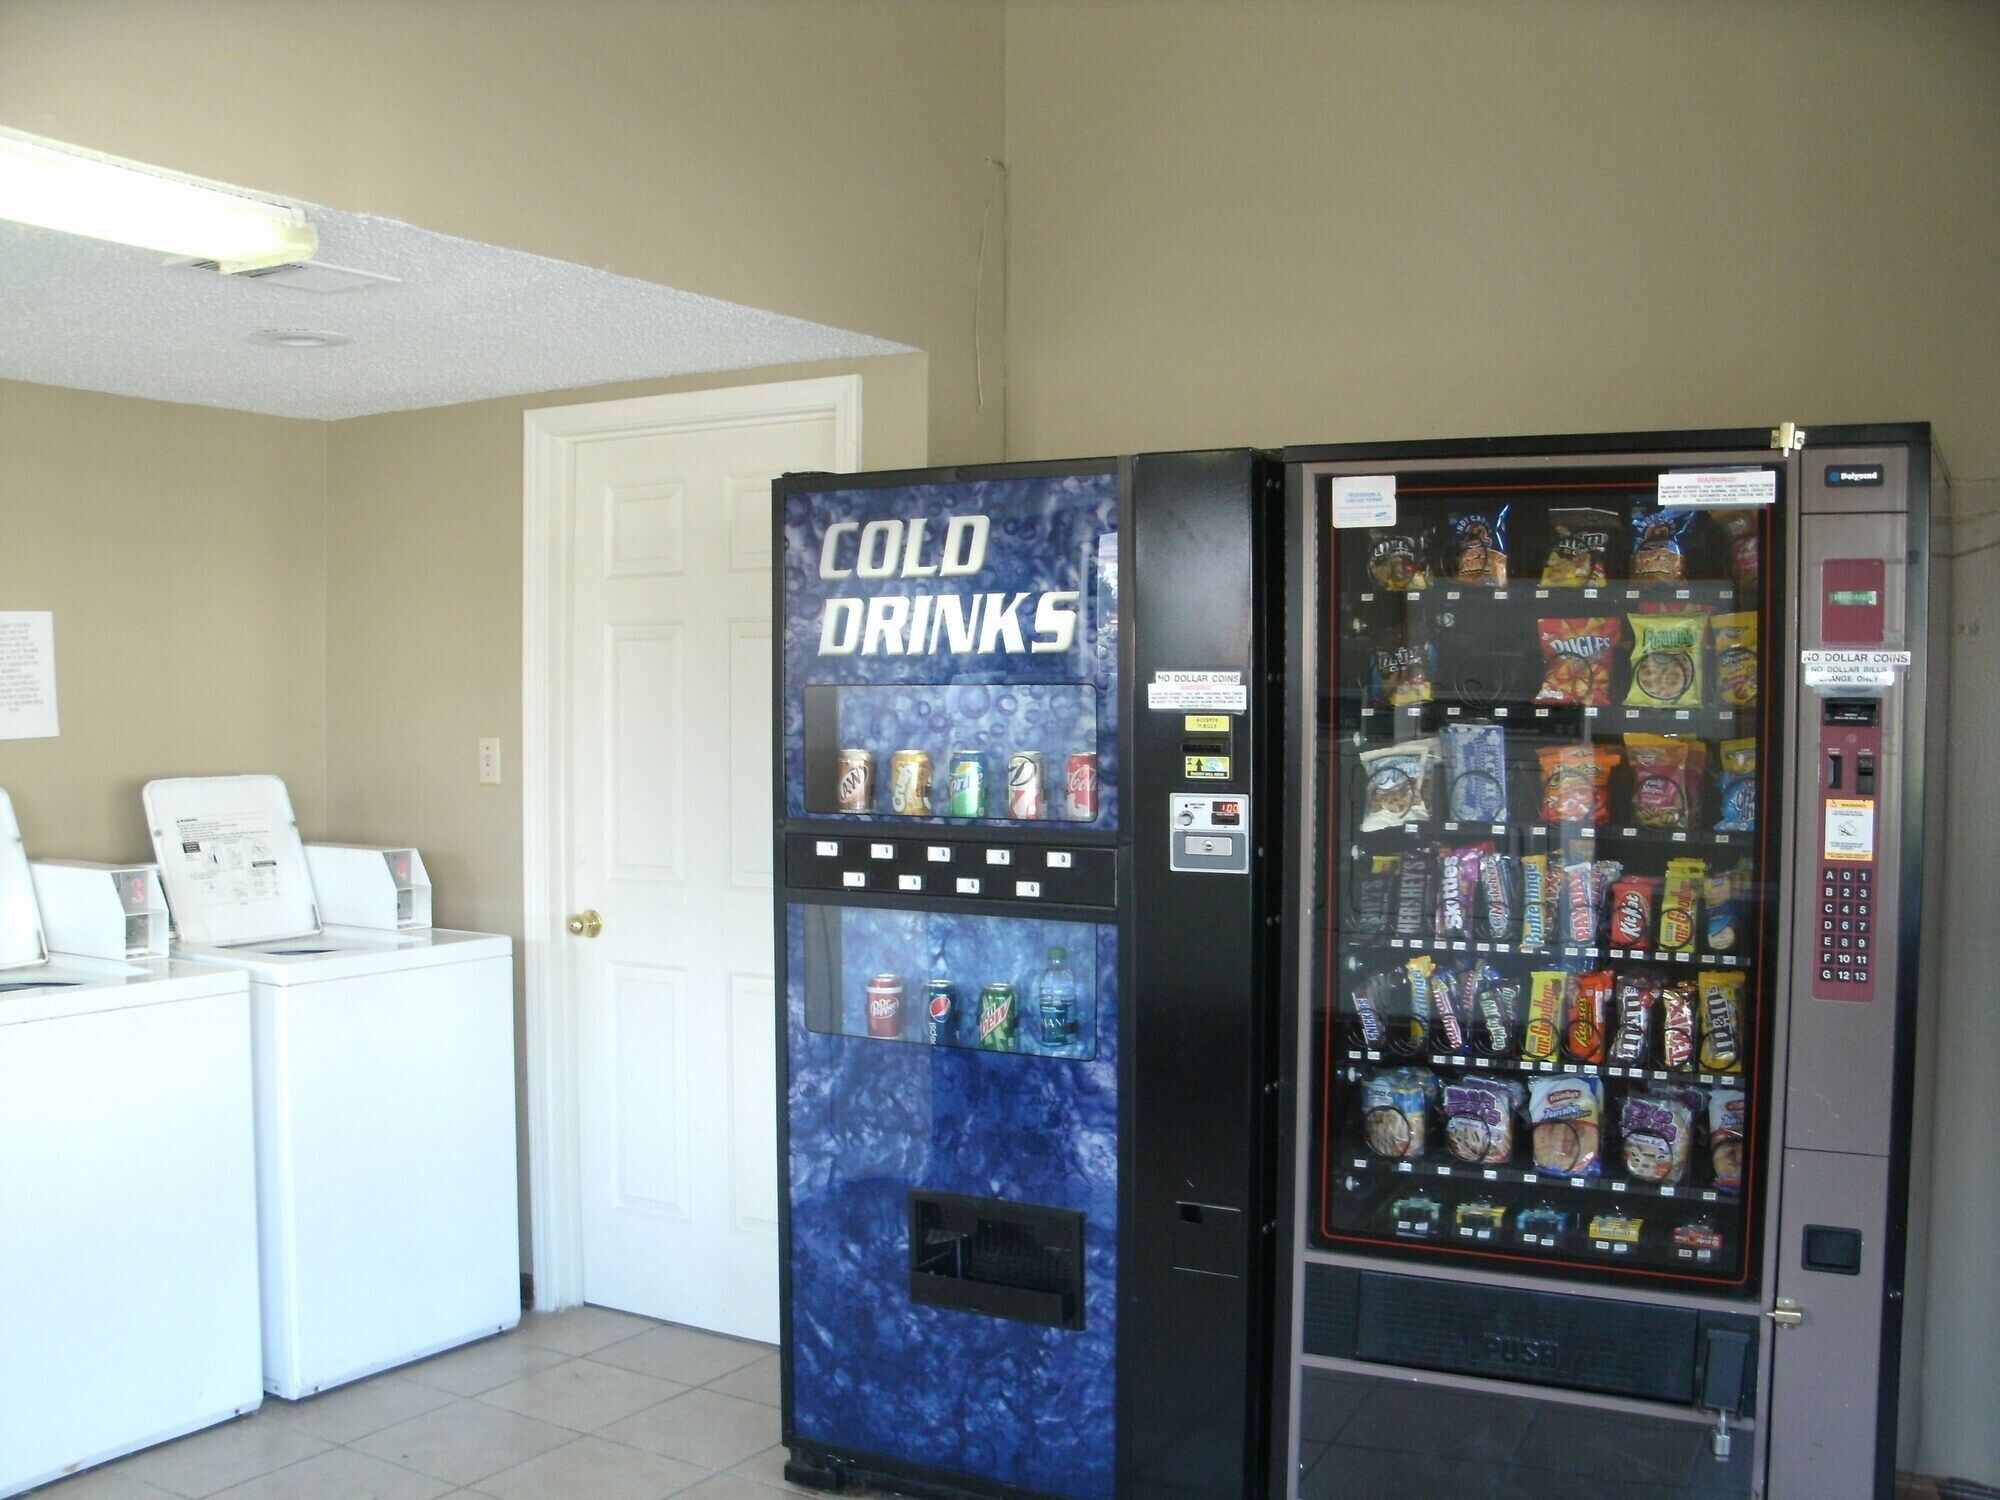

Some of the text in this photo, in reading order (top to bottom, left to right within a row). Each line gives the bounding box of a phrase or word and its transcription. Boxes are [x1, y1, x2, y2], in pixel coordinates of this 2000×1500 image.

[820, 514, 990, 579] COLD
[817, 591, 1080, 656] DRINKS
[1803, 653, 1908, 663] NO DOLLAR COINS
[1158, 674, 1239, 682] NO DOLLAR COINS
[1826, 871, 1866, 881] A 0 1
[1826, 888, 1867, 898] B 2 3
[1824, 904, 1866, 914] C 4 5
[1824, 921, 1866, 930] D 6 7
[1824, 937, 1866, 948] E 8 9
[1824, 954, 1866, 964] F 10 11
[1822, 970, 1866, 980] G 12 13
[1357, 998, 1378, 1041] SNICKERS
